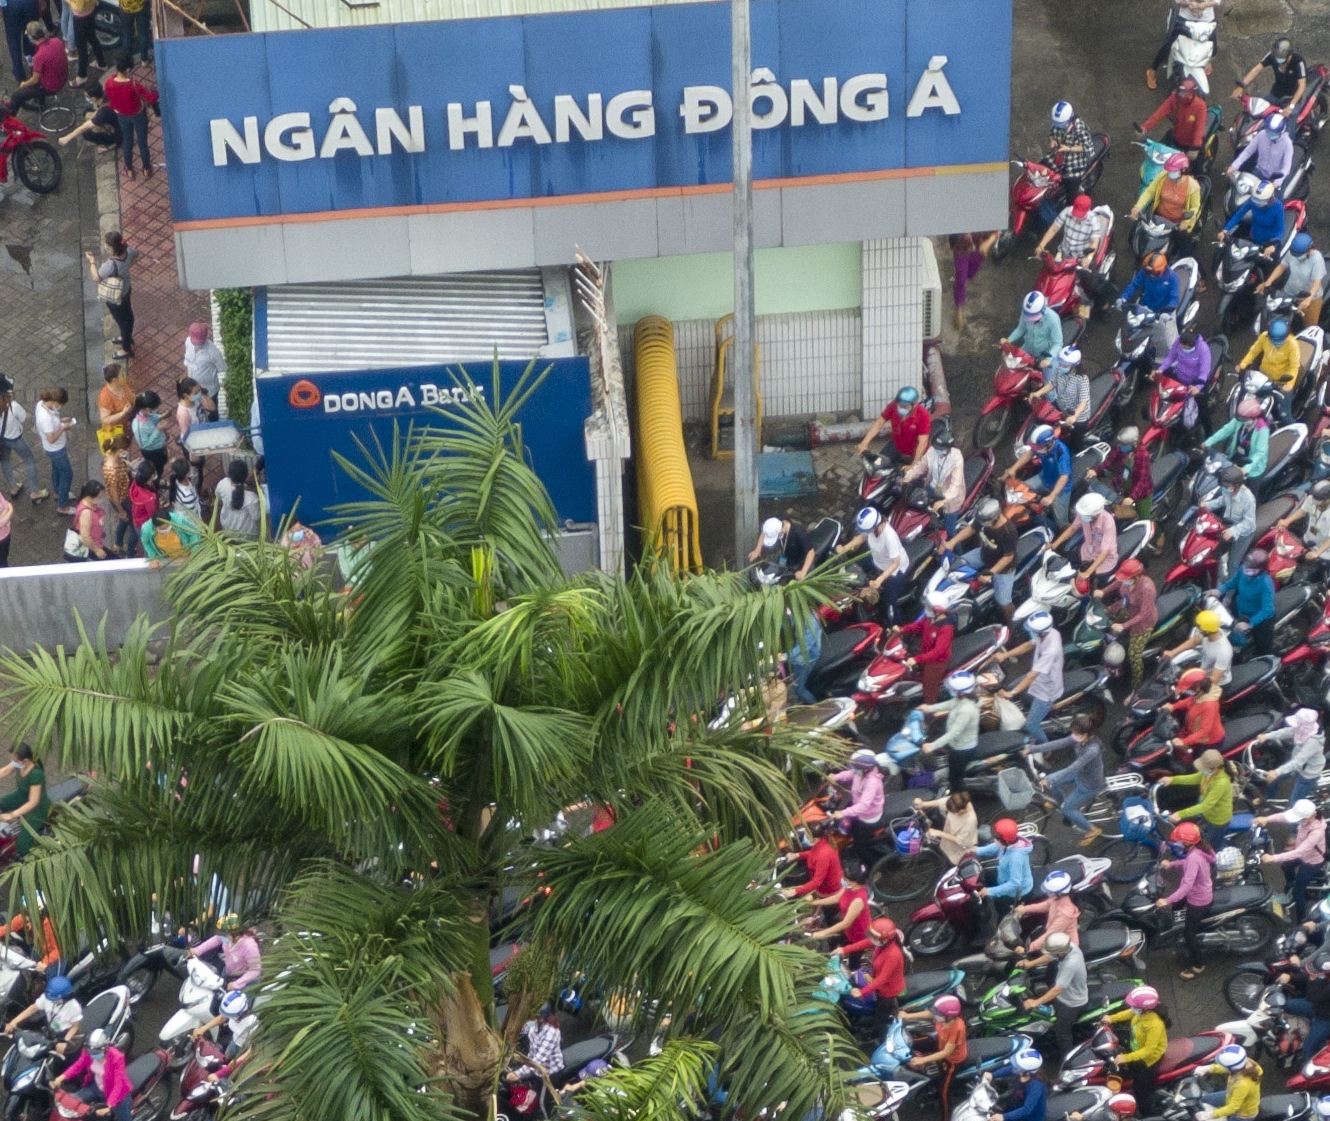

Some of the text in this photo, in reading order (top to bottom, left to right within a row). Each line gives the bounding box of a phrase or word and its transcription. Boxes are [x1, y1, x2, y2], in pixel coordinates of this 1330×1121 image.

[210, 55, 961, 166] NGÂN HÀNG ĐÔNG Á
